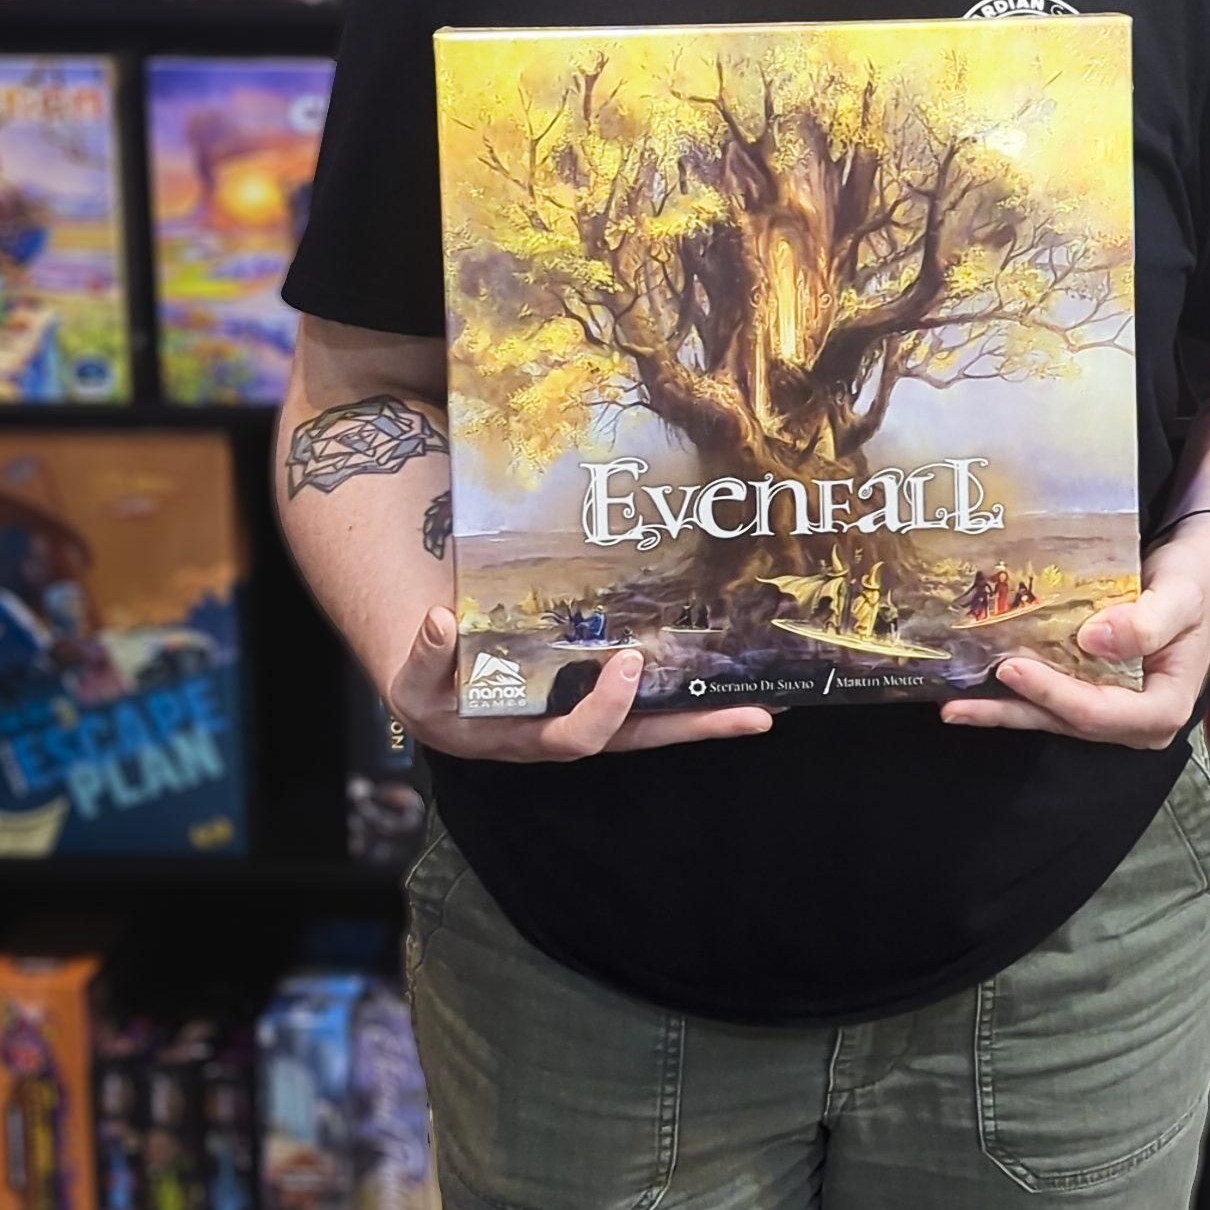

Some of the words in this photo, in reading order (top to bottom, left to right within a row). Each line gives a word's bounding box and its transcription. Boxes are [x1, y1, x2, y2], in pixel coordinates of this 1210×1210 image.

[709, 679, 757, 694] Stefano
[836, 676, 880, 689] Martin
[468, 685, 526, 700] nanox
[14, 679, 228, 790] ESCAPE
[68, 727, 228, 821] PLAN
